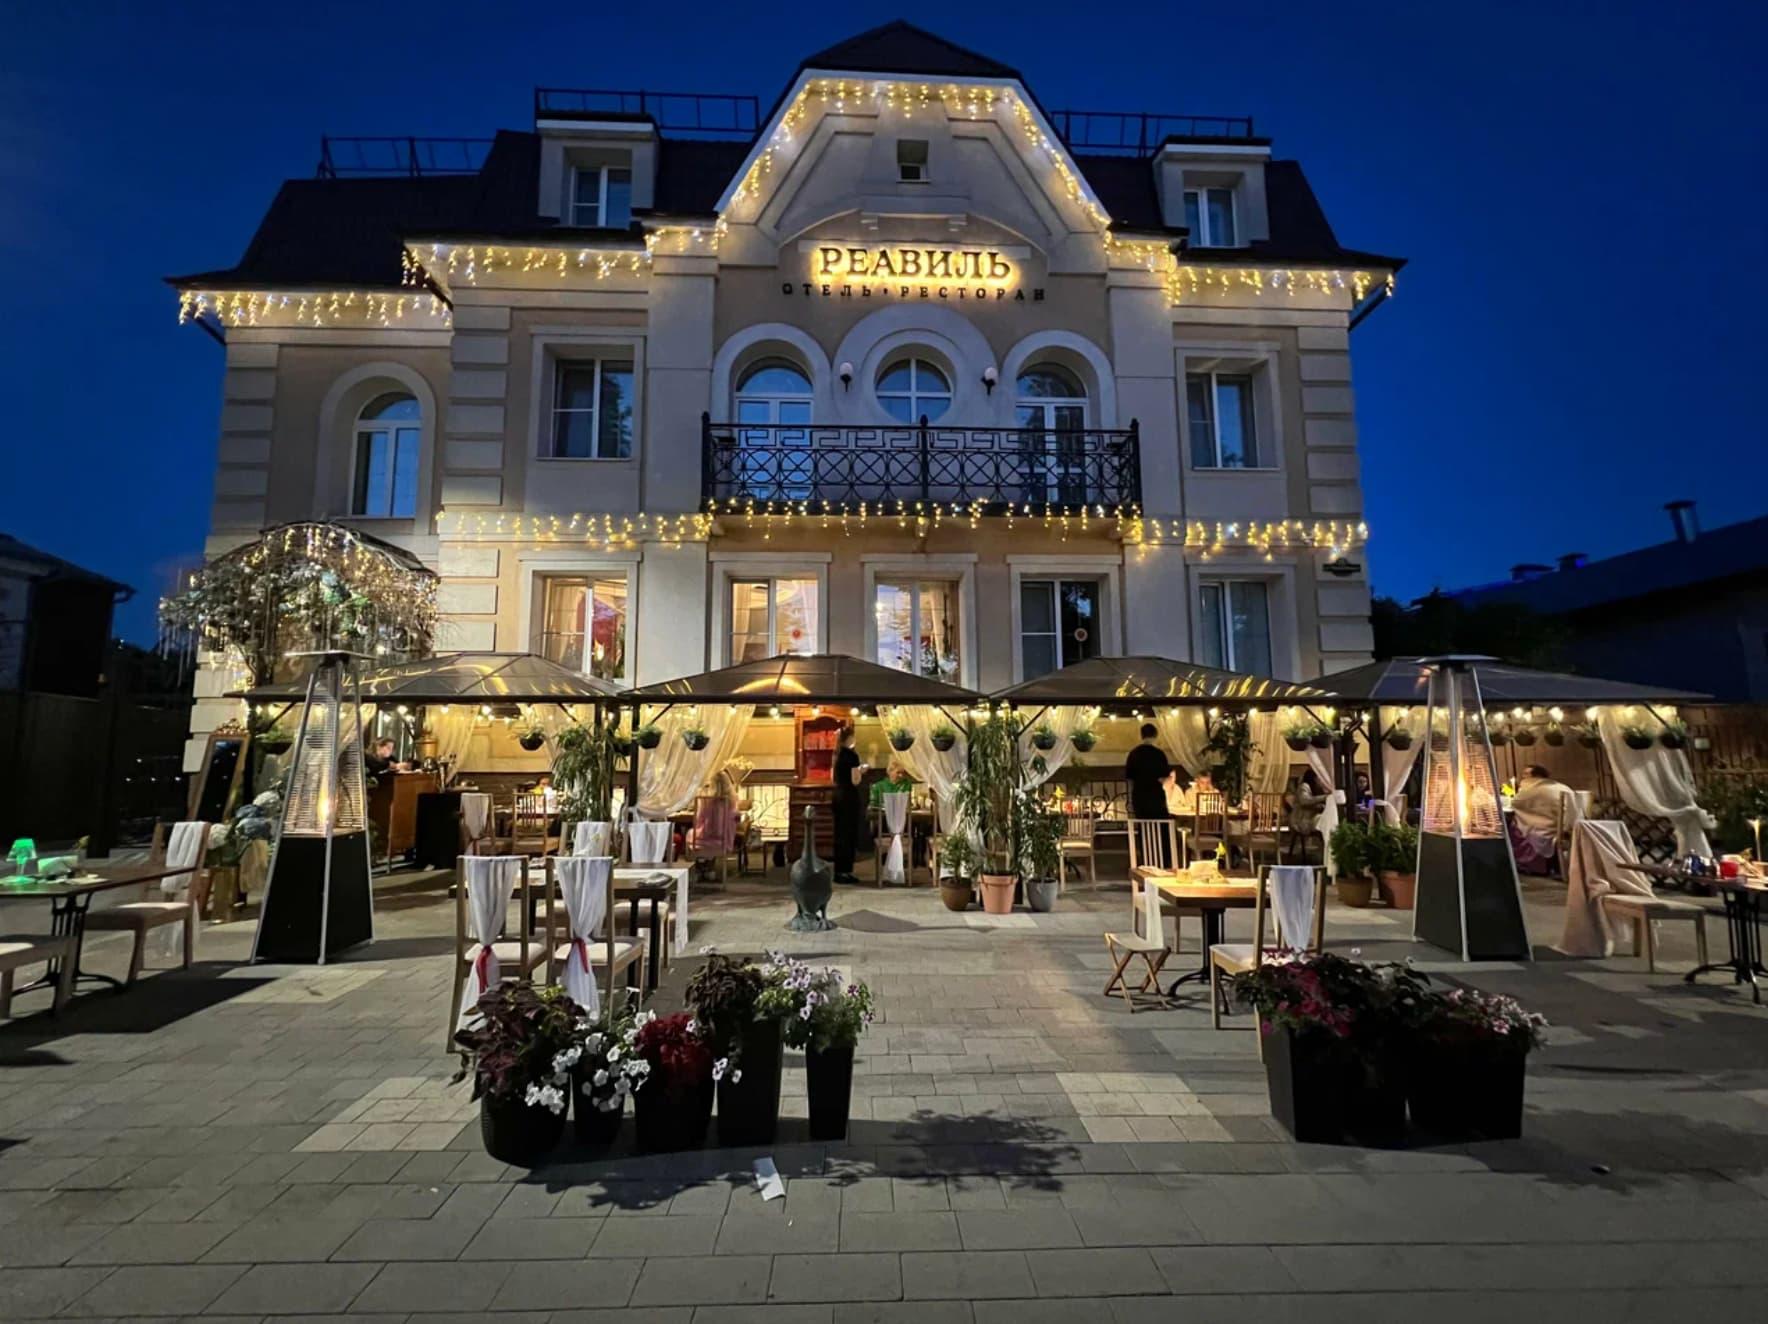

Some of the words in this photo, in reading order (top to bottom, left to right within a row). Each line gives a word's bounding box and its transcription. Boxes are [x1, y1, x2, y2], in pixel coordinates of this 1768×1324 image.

[819, 247, 1011, 280] РЕАВИЛЬ
[782, 282, 872, 298] ОТЕЛЬ
[900, 286, 1045, 301] РЕСТОРАН
